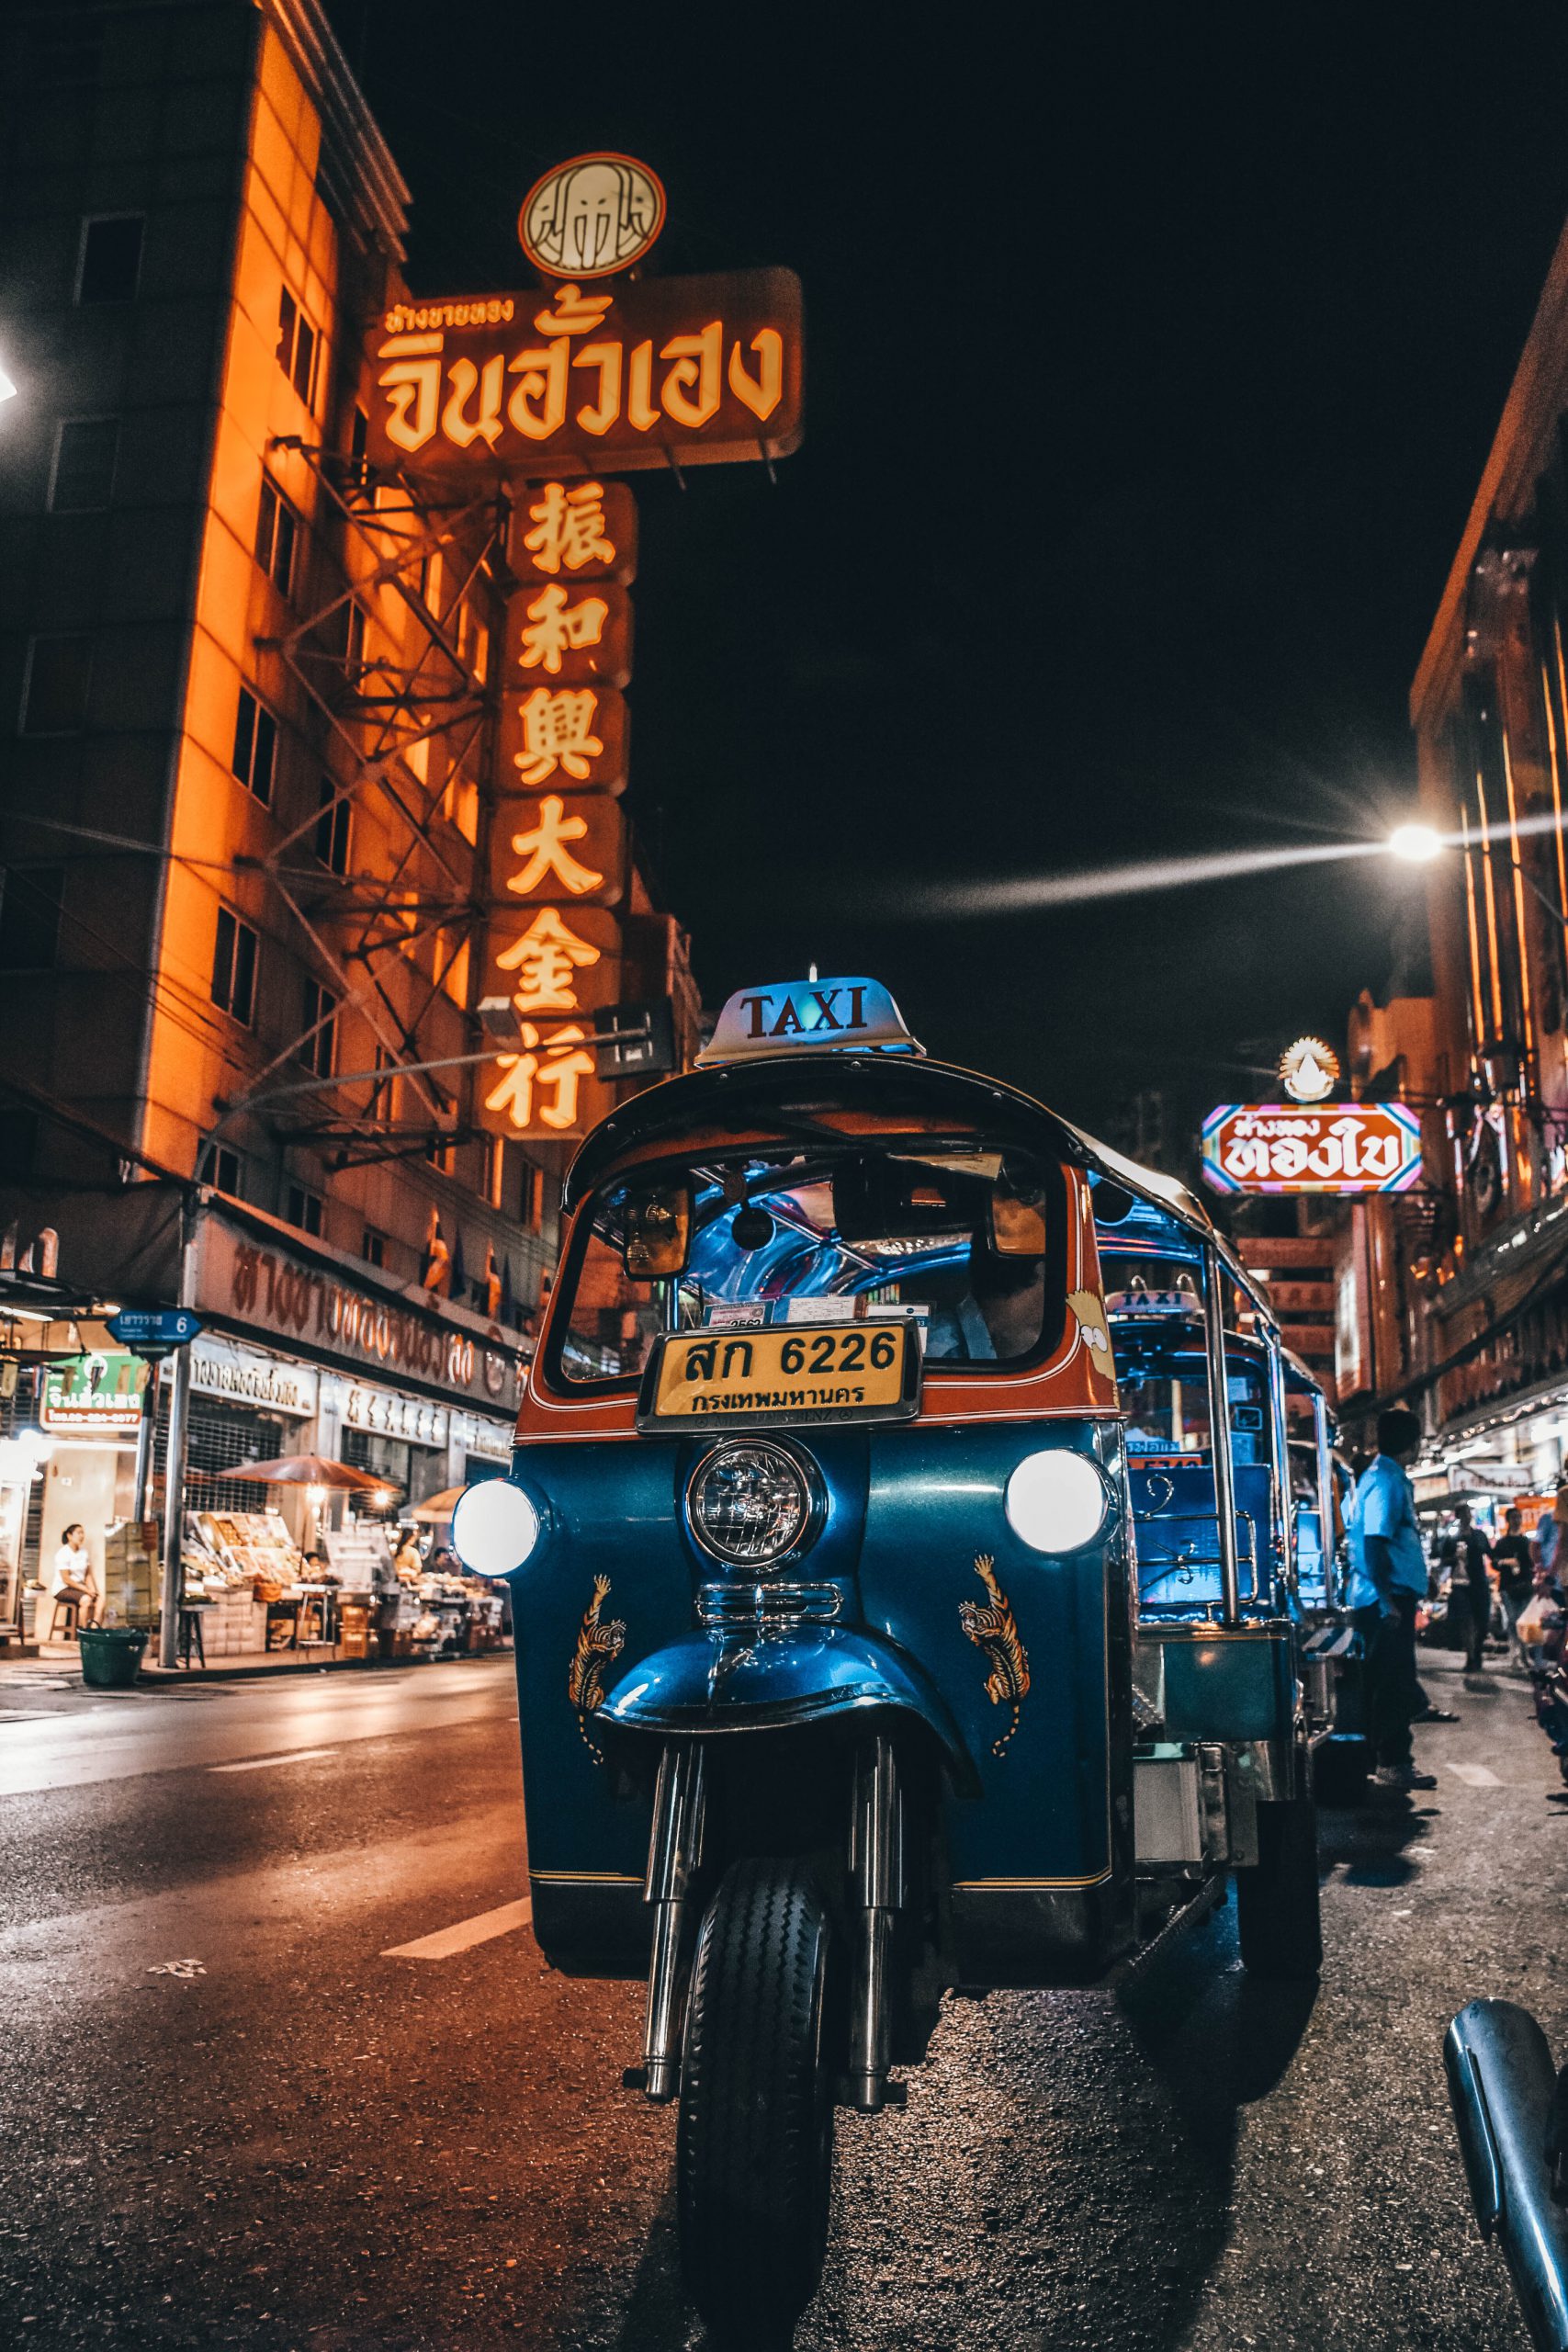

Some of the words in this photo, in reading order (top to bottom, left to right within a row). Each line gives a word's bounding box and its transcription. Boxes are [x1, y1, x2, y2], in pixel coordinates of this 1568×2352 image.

[385, 300, 514, 334] ห้างขายทอง
[485, 482, 615, 1128] 振和興大金行
[739, 986, 868, 1039] TAXI
[1123, 1293, 1182, 1306] TAXI
[176, 1317, 187, 1333] 6
[685, 1340, 753, 1383] สก
[781, 1332, 897, 1375] 6226
[692, 1386, 865, 1412] กรงเทพมหานคร
